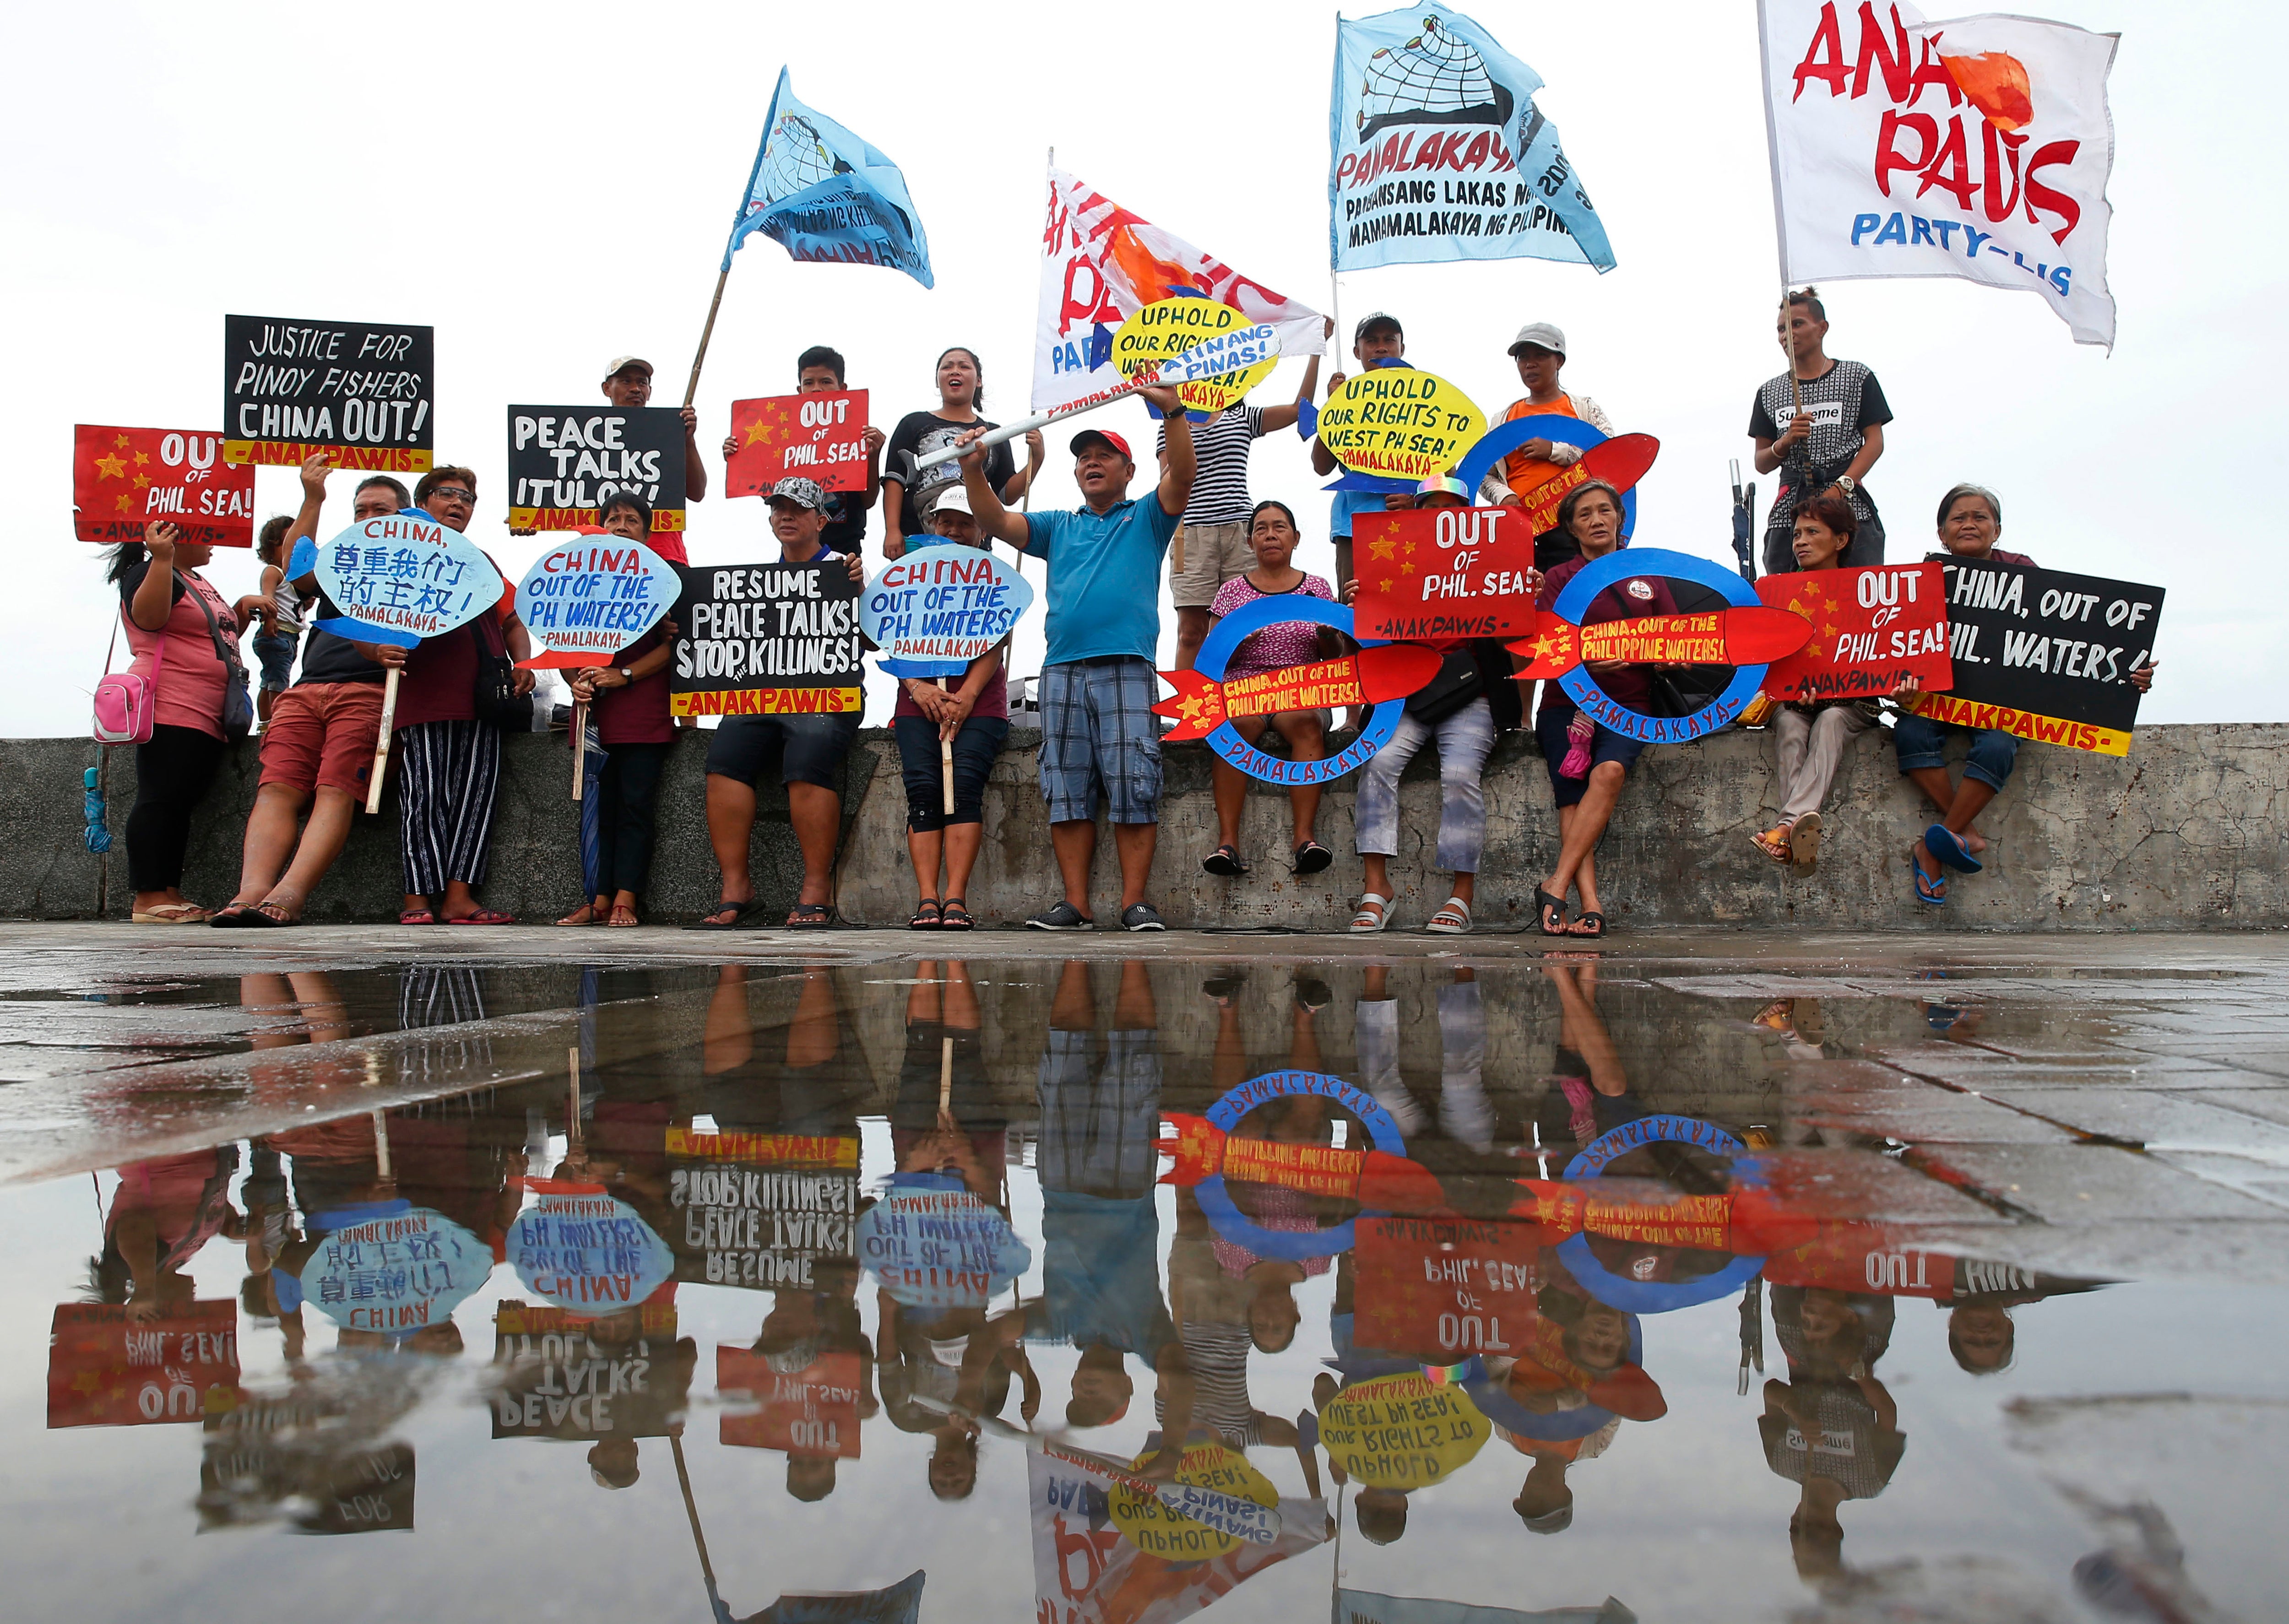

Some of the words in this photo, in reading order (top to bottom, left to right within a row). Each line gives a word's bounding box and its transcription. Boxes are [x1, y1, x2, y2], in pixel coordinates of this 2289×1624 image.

[1792, 0, 1976, 108] ANA
[1444, 180, 1506, 207] LAKAS
[1484, 213, 1508, 237] NG
[1142, 307, 1231, 328] UPHOLD
[249, 324, 346, 360] JUSTICE
[358, 333, 412, 362] FOR
[1121, 335, 1159, 352] OUR
[1164, 338, 1224, 373] ATIN
[1227, 325, 1273, 347] ANG
[1186, 341, 1265, 380] PINAS!
[234, 362, 315, 397] PINOY
[319, 367, 422, 399] FISHERS
[1346, 379, 1436, 400] UPHOLD
[239, 403, 334, 439] CHINA
[343, 398, 429, 443] OUT!
[800, 399, 849, 428] OUT
[1323, 409, 1354, 426] OUR
[1360, 402, 1442, 428] RIGHTS
[1447, 413, 1470, 432] TO
[1778, 409, 1839, 423] Sueme
[515, 416, 626, 451] PEACE
[813, 428, 829, 441] OF
[1328, 430, 1380, 448] WEST
[1383, 431, 1407, 449] PH
[1408, 434, 1456, 458] SEA!
[550, 449, 661, 483] TALKS
[784, 444, 824, 469] PHIL.
[827, 438, 867, 464] SEA!
[185, 470, 212, 483] OF
[1524, 482, 1551, 509] OUT
[1551, 478, 1563, 494] OF
[1561, 463, 1588, 487] THE
[146, 486, 193, 514] PHIL.
[199, 487, 252, 518] SEA!
[364, 520, 448, 548] CHINA,
[1436, 510, 1506, 548] OUT
[330, 542, 467, 586] 尊重我们
[544, 548, 649, 576] CHINA,
[882, 558, 1002, 587] CHINA,
[1454, 551, 1480, 571] OF
[528, 575, 573, 596] OUT
[572, 574, 602, 597] OF
[610, 575, 654, 600] THE
[713, 568, 821, 600] RESUME
[871, 590, 917, 613] OUT
[924, 586, 957, 610] OF
[962, 585, 1010, 609] THE
[1422, 573, 1477, 601] PHIL.
[1482, 566, 1533, 595] SEA!
[1857, 570, 1922, 608] OUT
[529, 601, 558, 627] PH
[565, 601, 659, 633] WATERS!
[692, 602, 766, 639] PEACE
[776, 597, 859, 636] TALKS!
[877, 613, 912, 641] PH
[922, 607, 1021, 636] WATERS!
[1872, 606, 1901, 628] OF
[2040, 589, 2100, 622] OUT
[2106, 599, 2152, 631] OF
[1580, 620, 1637, 640] CHINA,
[1638, 617, 1669, 634] OUT
[1671, 620, 1687, 632] OF
[1690, 615, 1717, 632] THE
[1833, 632, 1886, 664] PHIL.
[1890, 622, 1944, 658] SEA!
[676, 639, 745, 678] STOP
[733, 664, 748, 682] THE
[749, 635, 859, 676] KILLINGS!
[1581, 638, 1663, 660] PHILIPPINE
[1665, 638, 1724, 662] WATERS!
[1947, 622, 1991, 664] HIL.
[2003, 630, 2148, 685] WATERS!
[1224, 674, 1279, 697] CHINA,
[1278, 666, 1306, 686] OUT
[1309, 665, 1324, 680] OF
[1327, 661, 1351, 678] THE
[1226, 687, 1297, 717] PHILIPPINE
[1299, 682, 1360, 706] WATERS!
